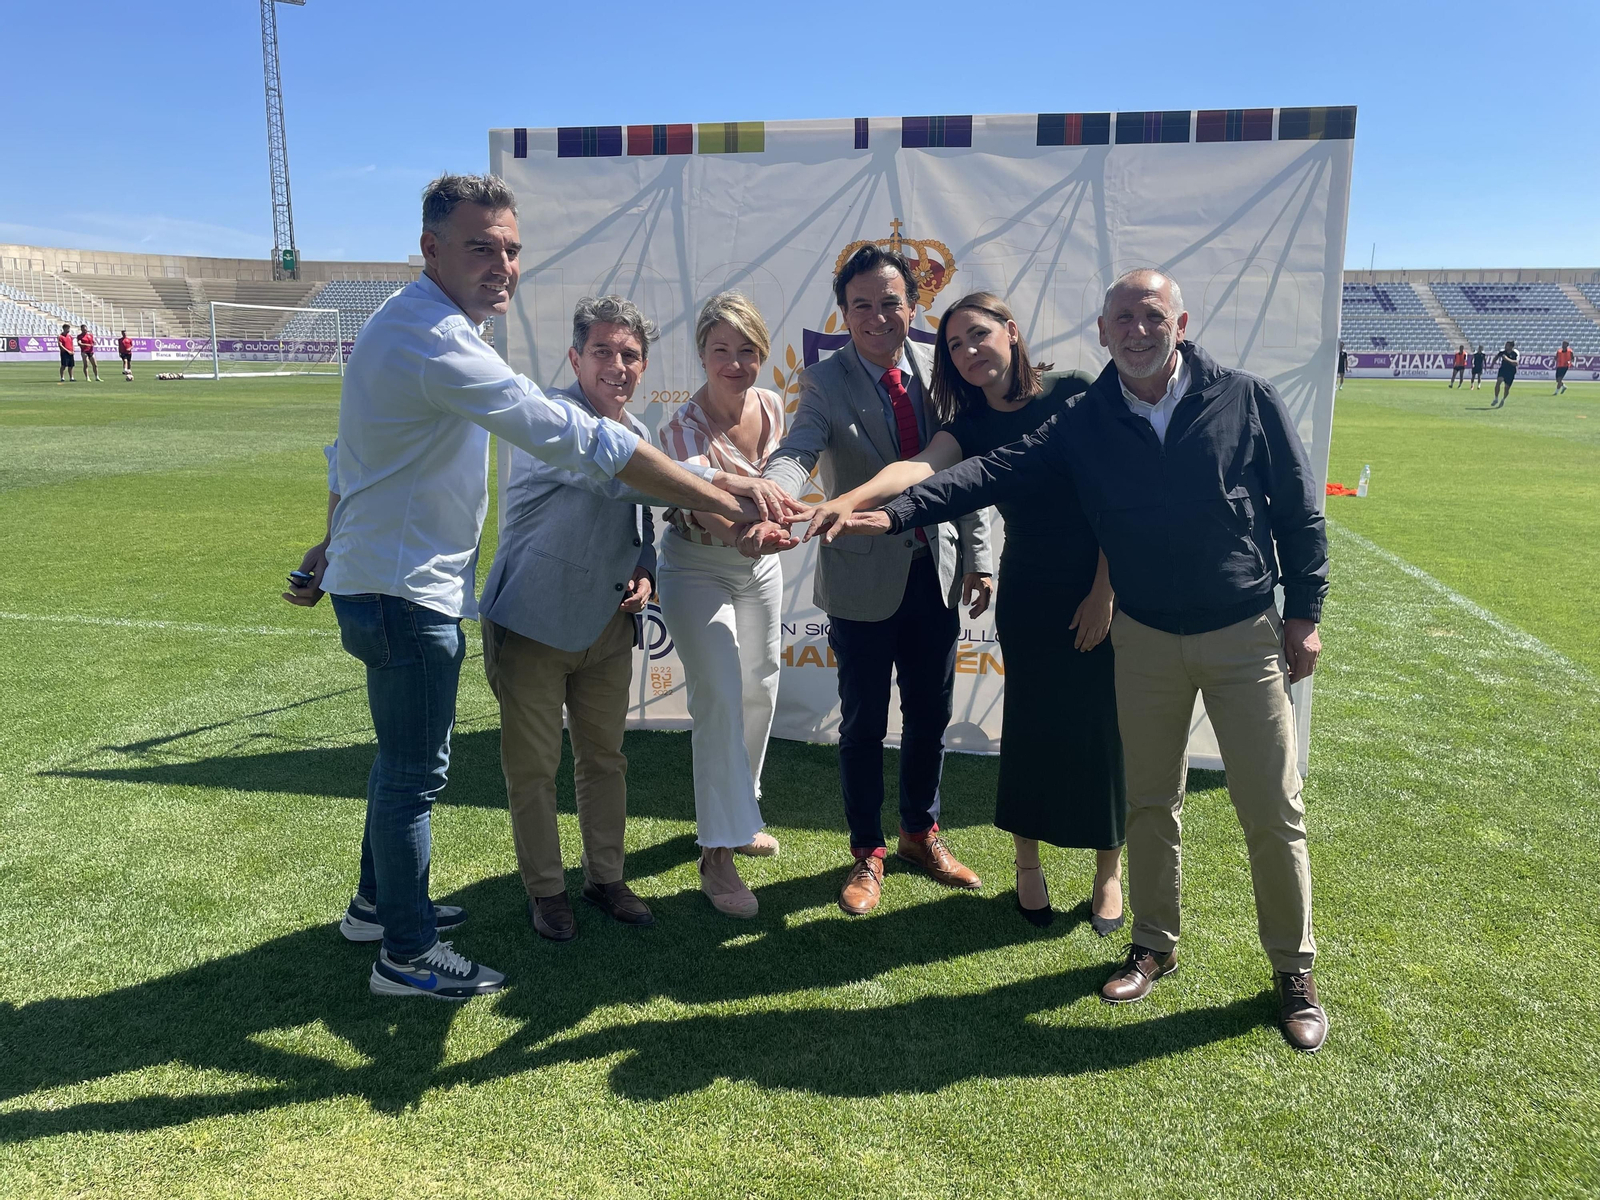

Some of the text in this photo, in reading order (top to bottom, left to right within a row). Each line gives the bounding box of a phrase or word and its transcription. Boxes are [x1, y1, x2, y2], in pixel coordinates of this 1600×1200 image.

[1519, 355, 1542, 366] TEGA
[651, 390, 690, 403] 2022
[957, 629, 1000, 642] ULL
[955, 643, 1004, 675] ÉN
[651, 673, 672, 681] RJ
[651, 681, 672, 689] CF
